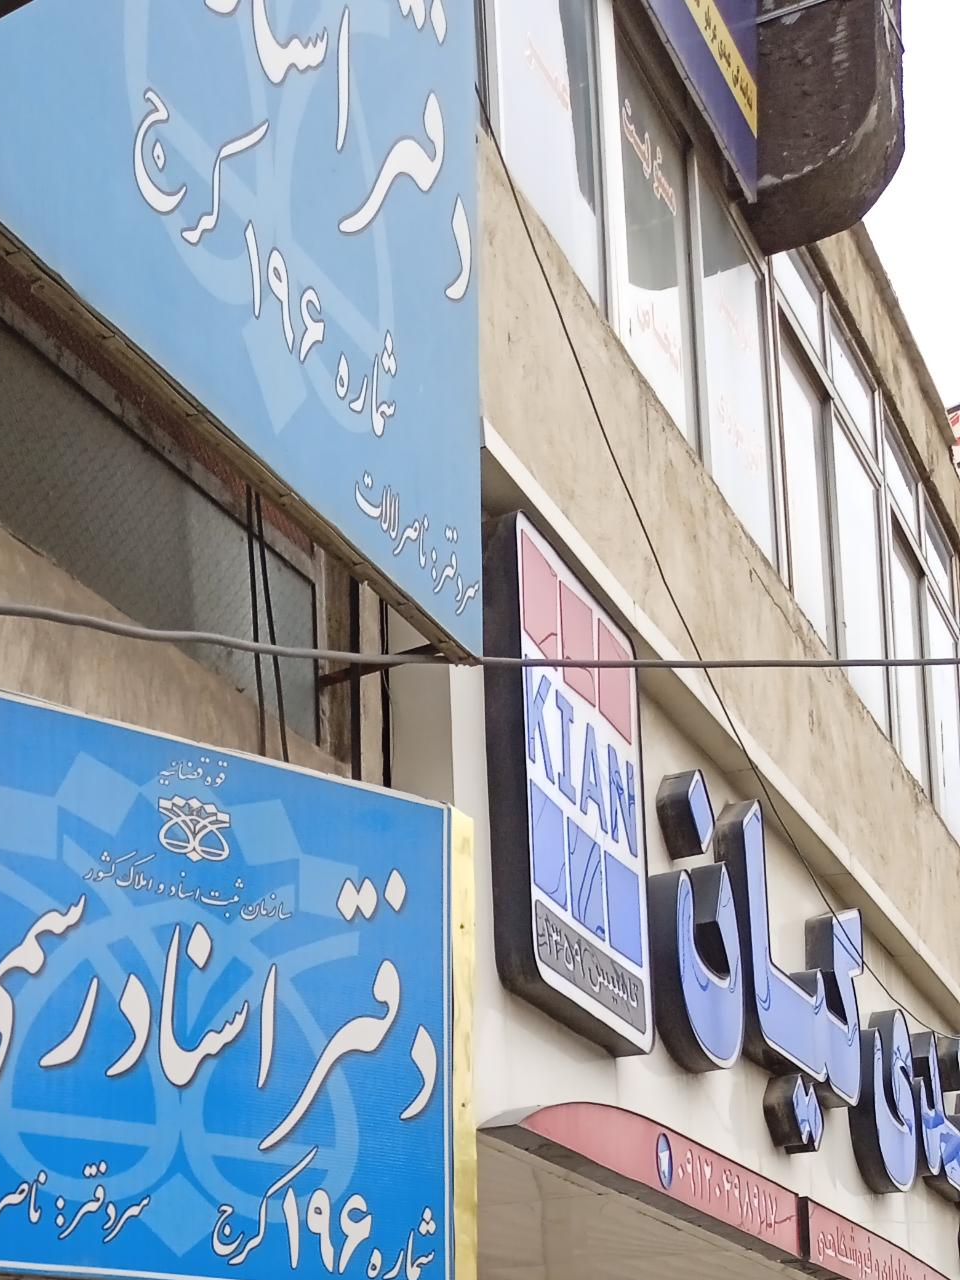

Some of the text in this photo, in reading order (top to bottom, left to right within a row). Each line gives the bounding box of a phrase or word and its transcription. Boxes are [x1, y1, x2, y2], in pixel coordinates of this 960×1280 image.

[133, 88, 397, 437] شماره ۱۹۶ کرج
[393, 514, 430, 569] ناصر
[204, 760, 229, 788] قوه
[524, 655, 638, 859] KIAN
[83, 849, 292, 921] سازمان ثبت اسناد و املاک کشور
[104, 922, 278, 1089] اسناد
[258, 868, 439, 1152] دفتر
[658, 768, 864, 1155] کیان
[211, 1144, 320, 1266] کرج
[282, 1185, 373, 1275] ۱۹۶
[816, 1226, 873, 1278] فروشگاهی
